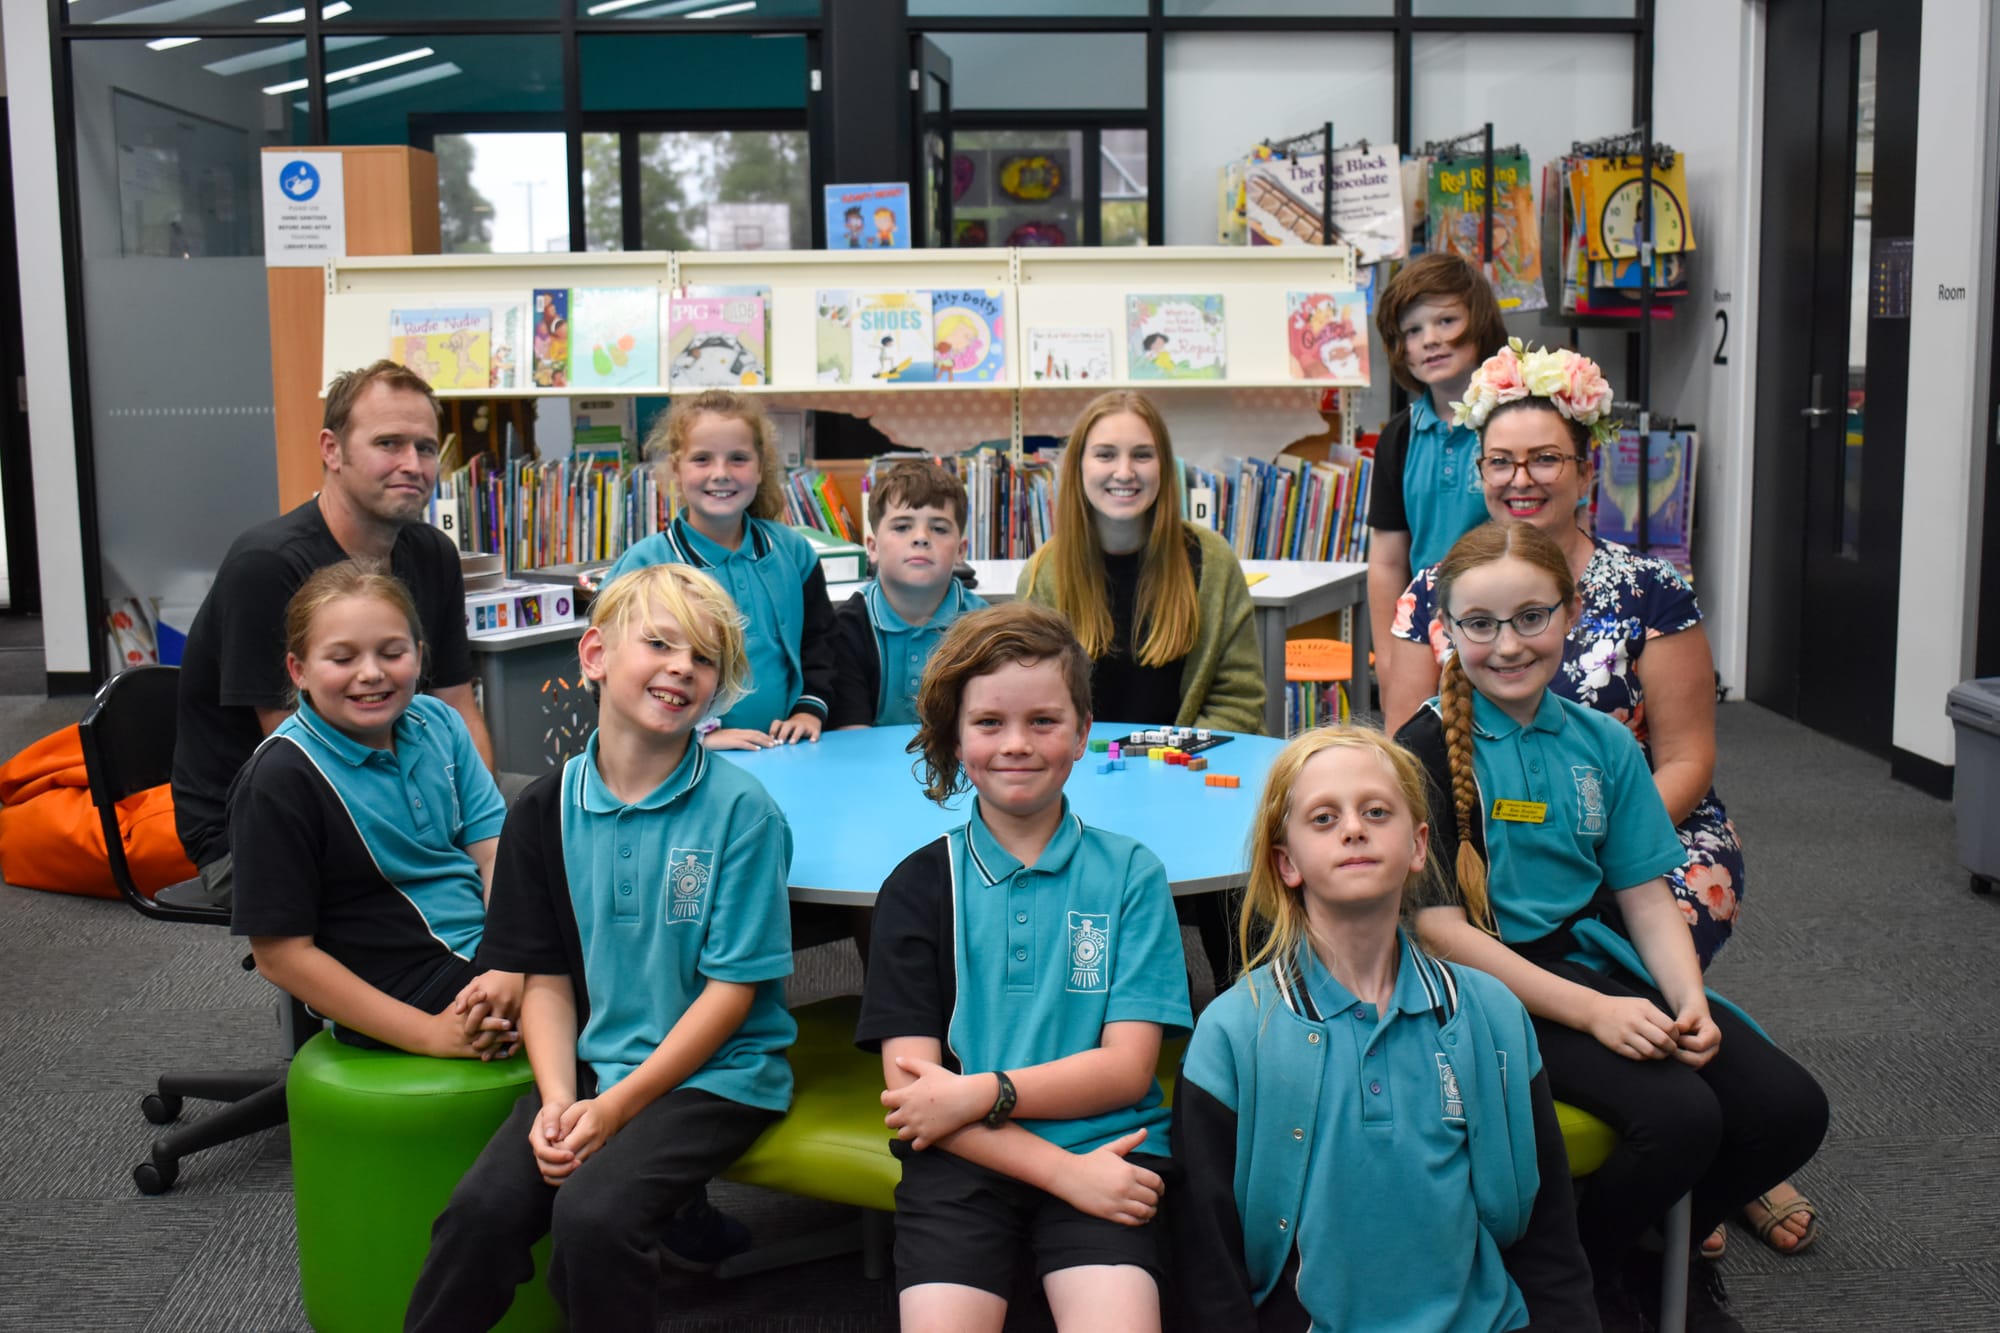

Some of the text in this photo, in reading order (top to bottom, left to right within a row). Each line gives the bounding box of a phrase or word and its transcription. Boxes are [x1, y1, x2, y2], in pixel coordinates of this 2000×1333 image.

[1288, 167, 1315, 180] The
[1347, 155, 1386, 172] Block
[1301, 181, 1314, 194] of
[1440, 169, 1466, 194] Red
[1610, 206, 1621, 217] 10
[1671, 219, 1678, 230] 3
[1938, 284, 1966, 300] Room
[677, 304, 709, 321] PIG
[861, 310, 922, 330] SHOES
[1713, 309, 1728, 366] 2
[1197, 504, 1206, 518] D
[443, 514, 453, 530] B
